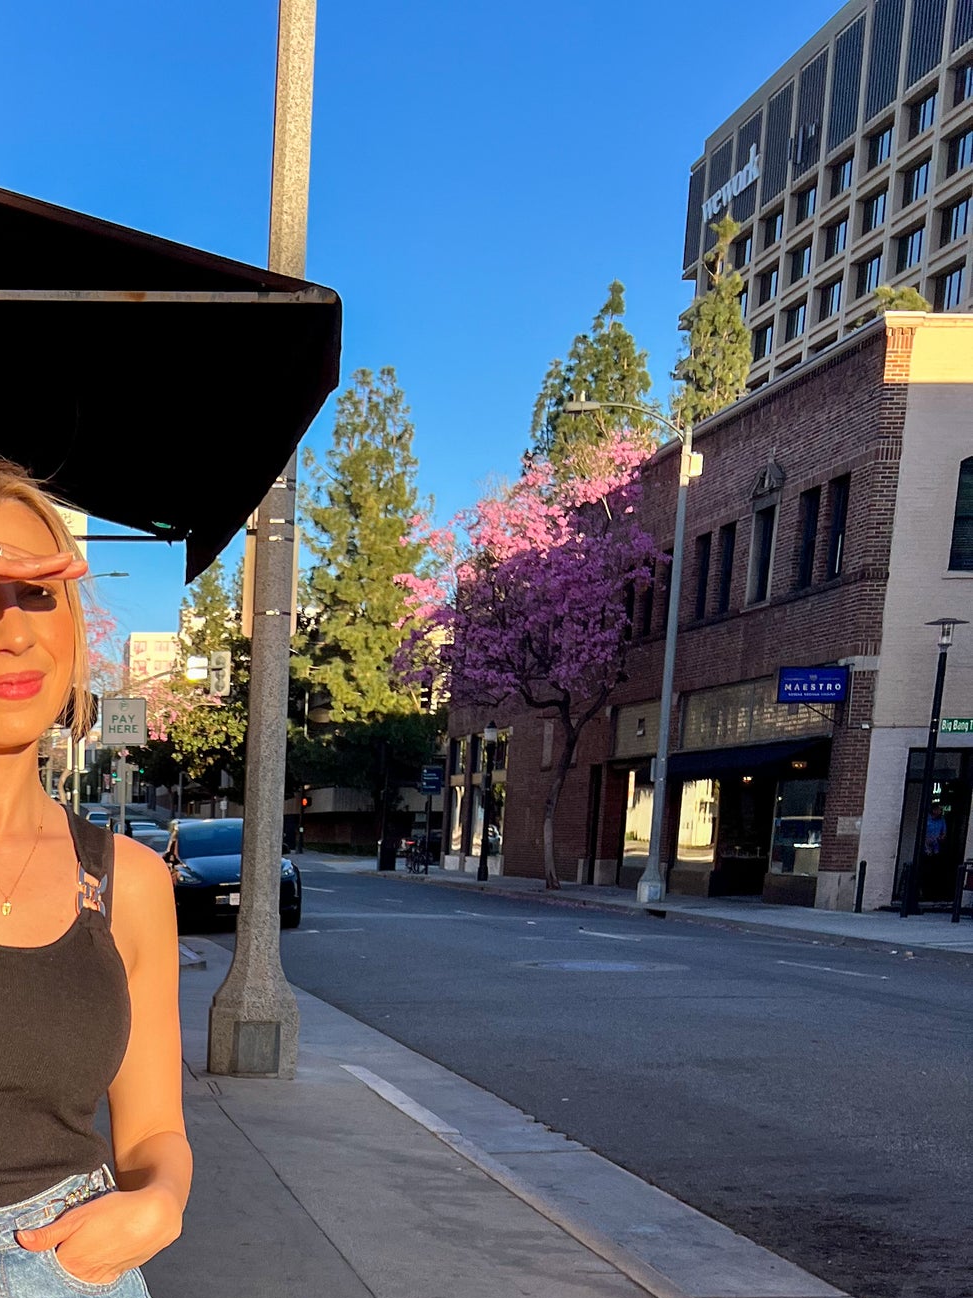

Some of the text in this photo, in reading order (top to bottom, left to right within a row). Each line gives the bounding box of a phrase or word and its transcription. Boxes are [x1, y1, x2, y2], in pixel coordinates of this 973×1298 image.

[701, 142, 761, 222] wework
[784, 683, 841, 691] MAESTRO
[111, 714, 135, 723] PAY
[108, 724, 139, 734] HERE
[941, 719, 952, 731] Big
[953, 719, 968, 732] Bang
